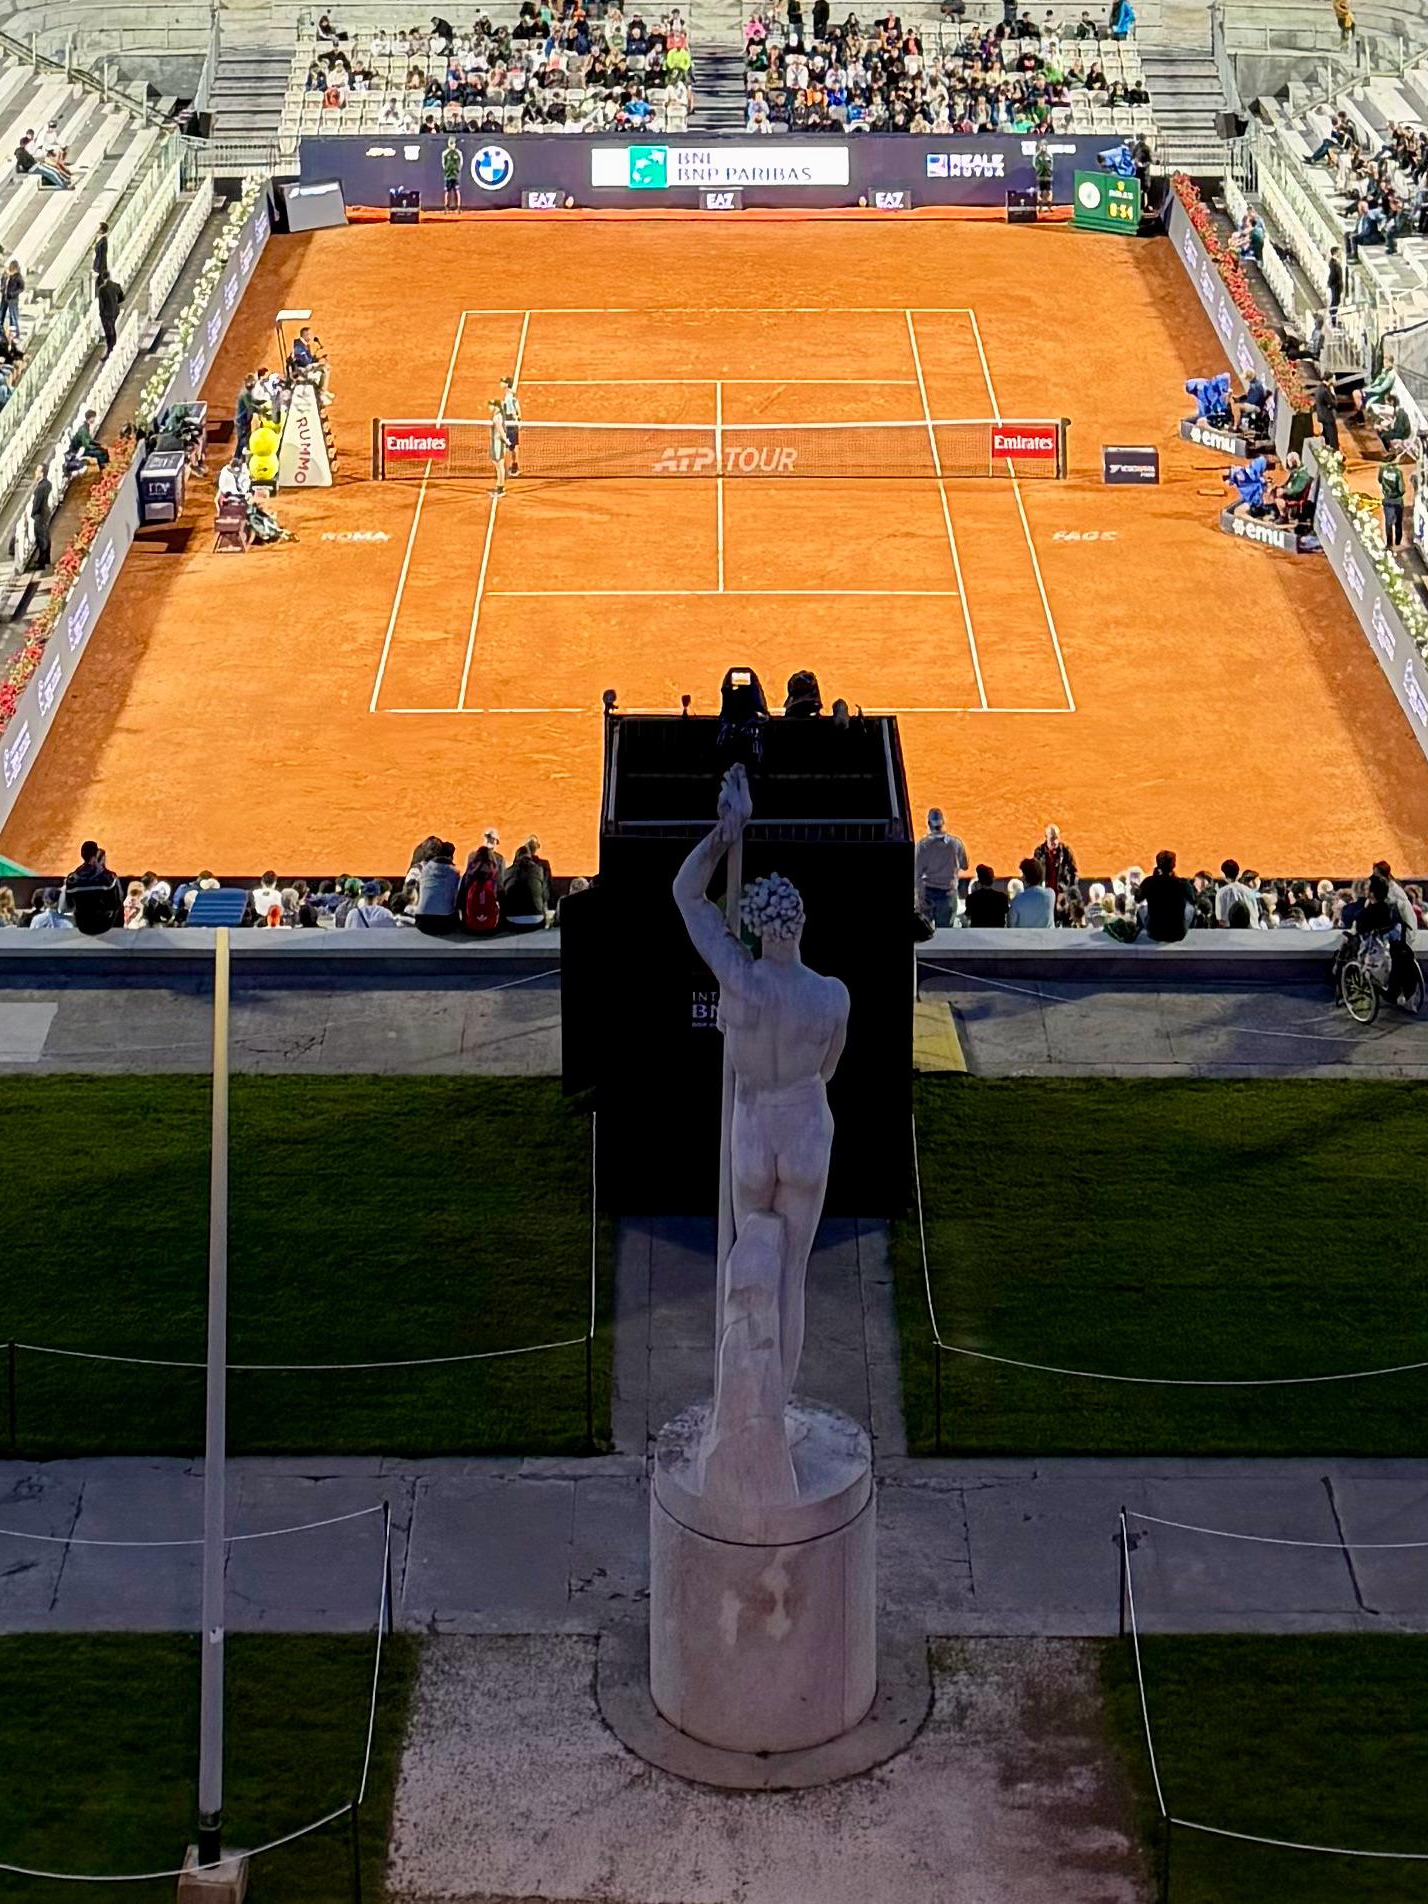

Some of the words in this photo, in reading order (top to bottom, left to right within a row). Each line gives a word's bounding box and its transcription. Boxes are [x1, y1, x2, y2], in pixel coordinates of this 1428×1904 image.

[678, 152, 712, 165] BNL
[678, 167, 720, 181] BNP
[725, 167, 812, 181] PARIBAS
[294, 416, 312, 484] RUMMO
[387, 435, 446, 451] Emirates
[993, 435, 1053, 450] Emirates
[1201, 430, 1236, 454] emu
[652, 447, 715, 472] ATP
[724, 447, 797, 472] TOUR
[1245, 522, 1285, 548] emu
